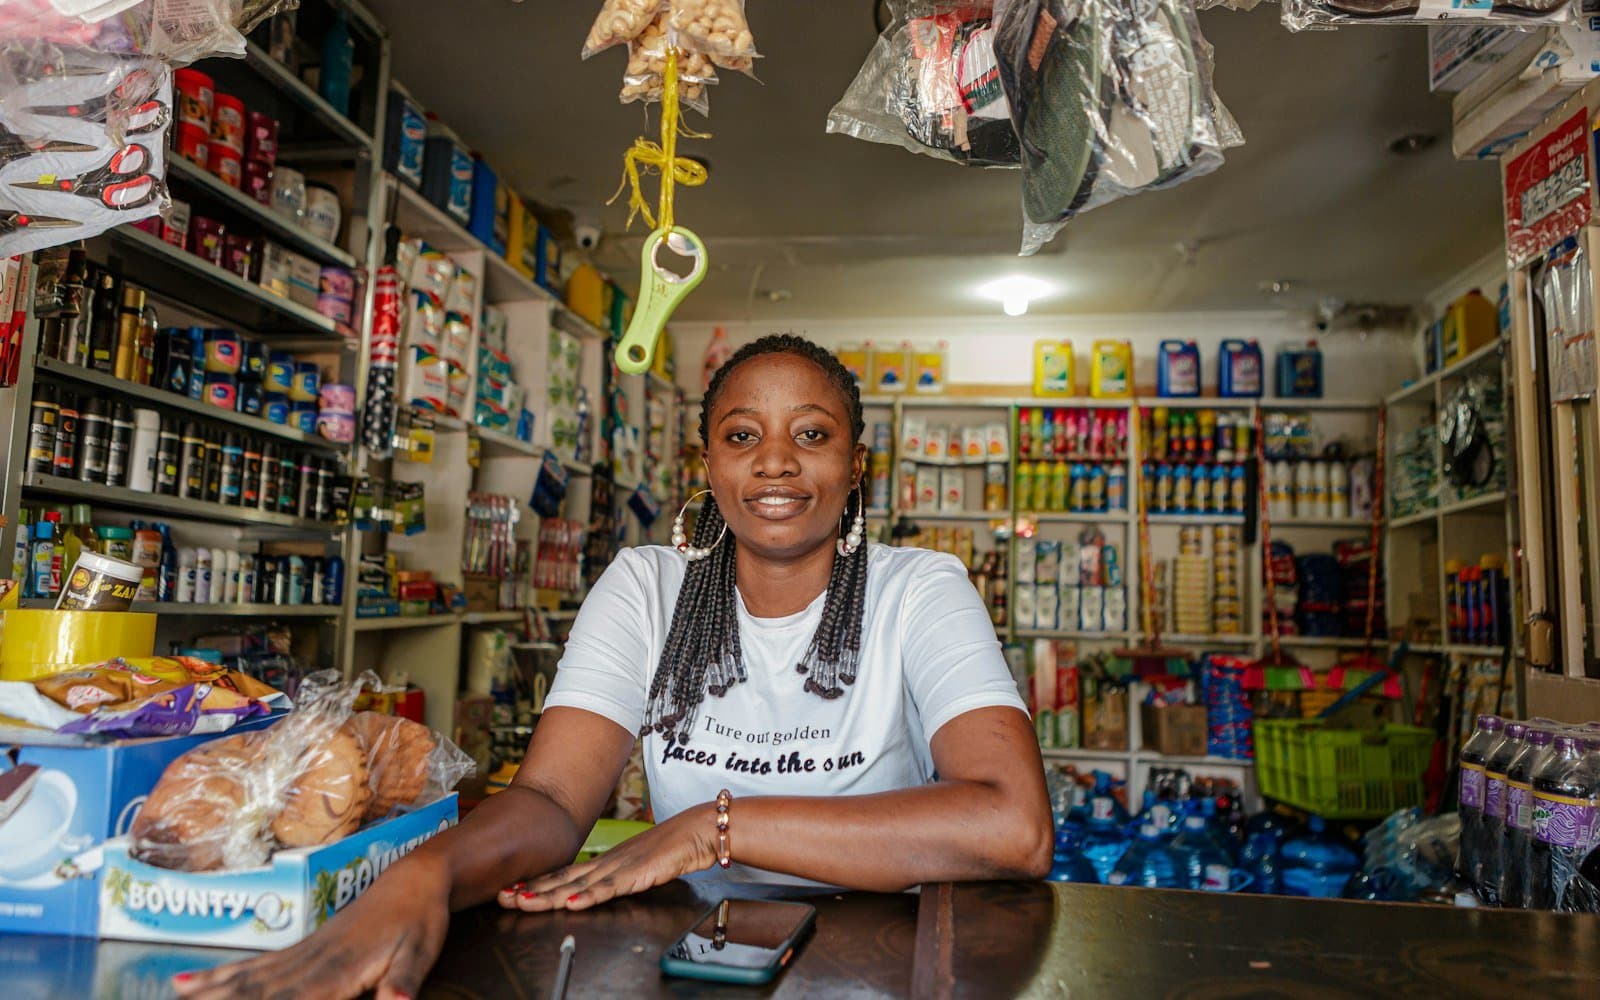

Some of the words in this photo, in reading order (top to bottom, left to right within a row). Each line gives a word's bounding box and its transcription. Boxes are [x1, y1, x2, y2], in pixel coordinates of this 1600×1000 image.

[704, 715, 742, 740] Ture
[746, 731, 771, 744] out
[772, 725, 831, 746] golden
[661, 738, 718, 765] faces
[725, 751, 772, 775] into
[777, 750, 816, 774] the
[129, 880, 248, 920] BOUNTY
